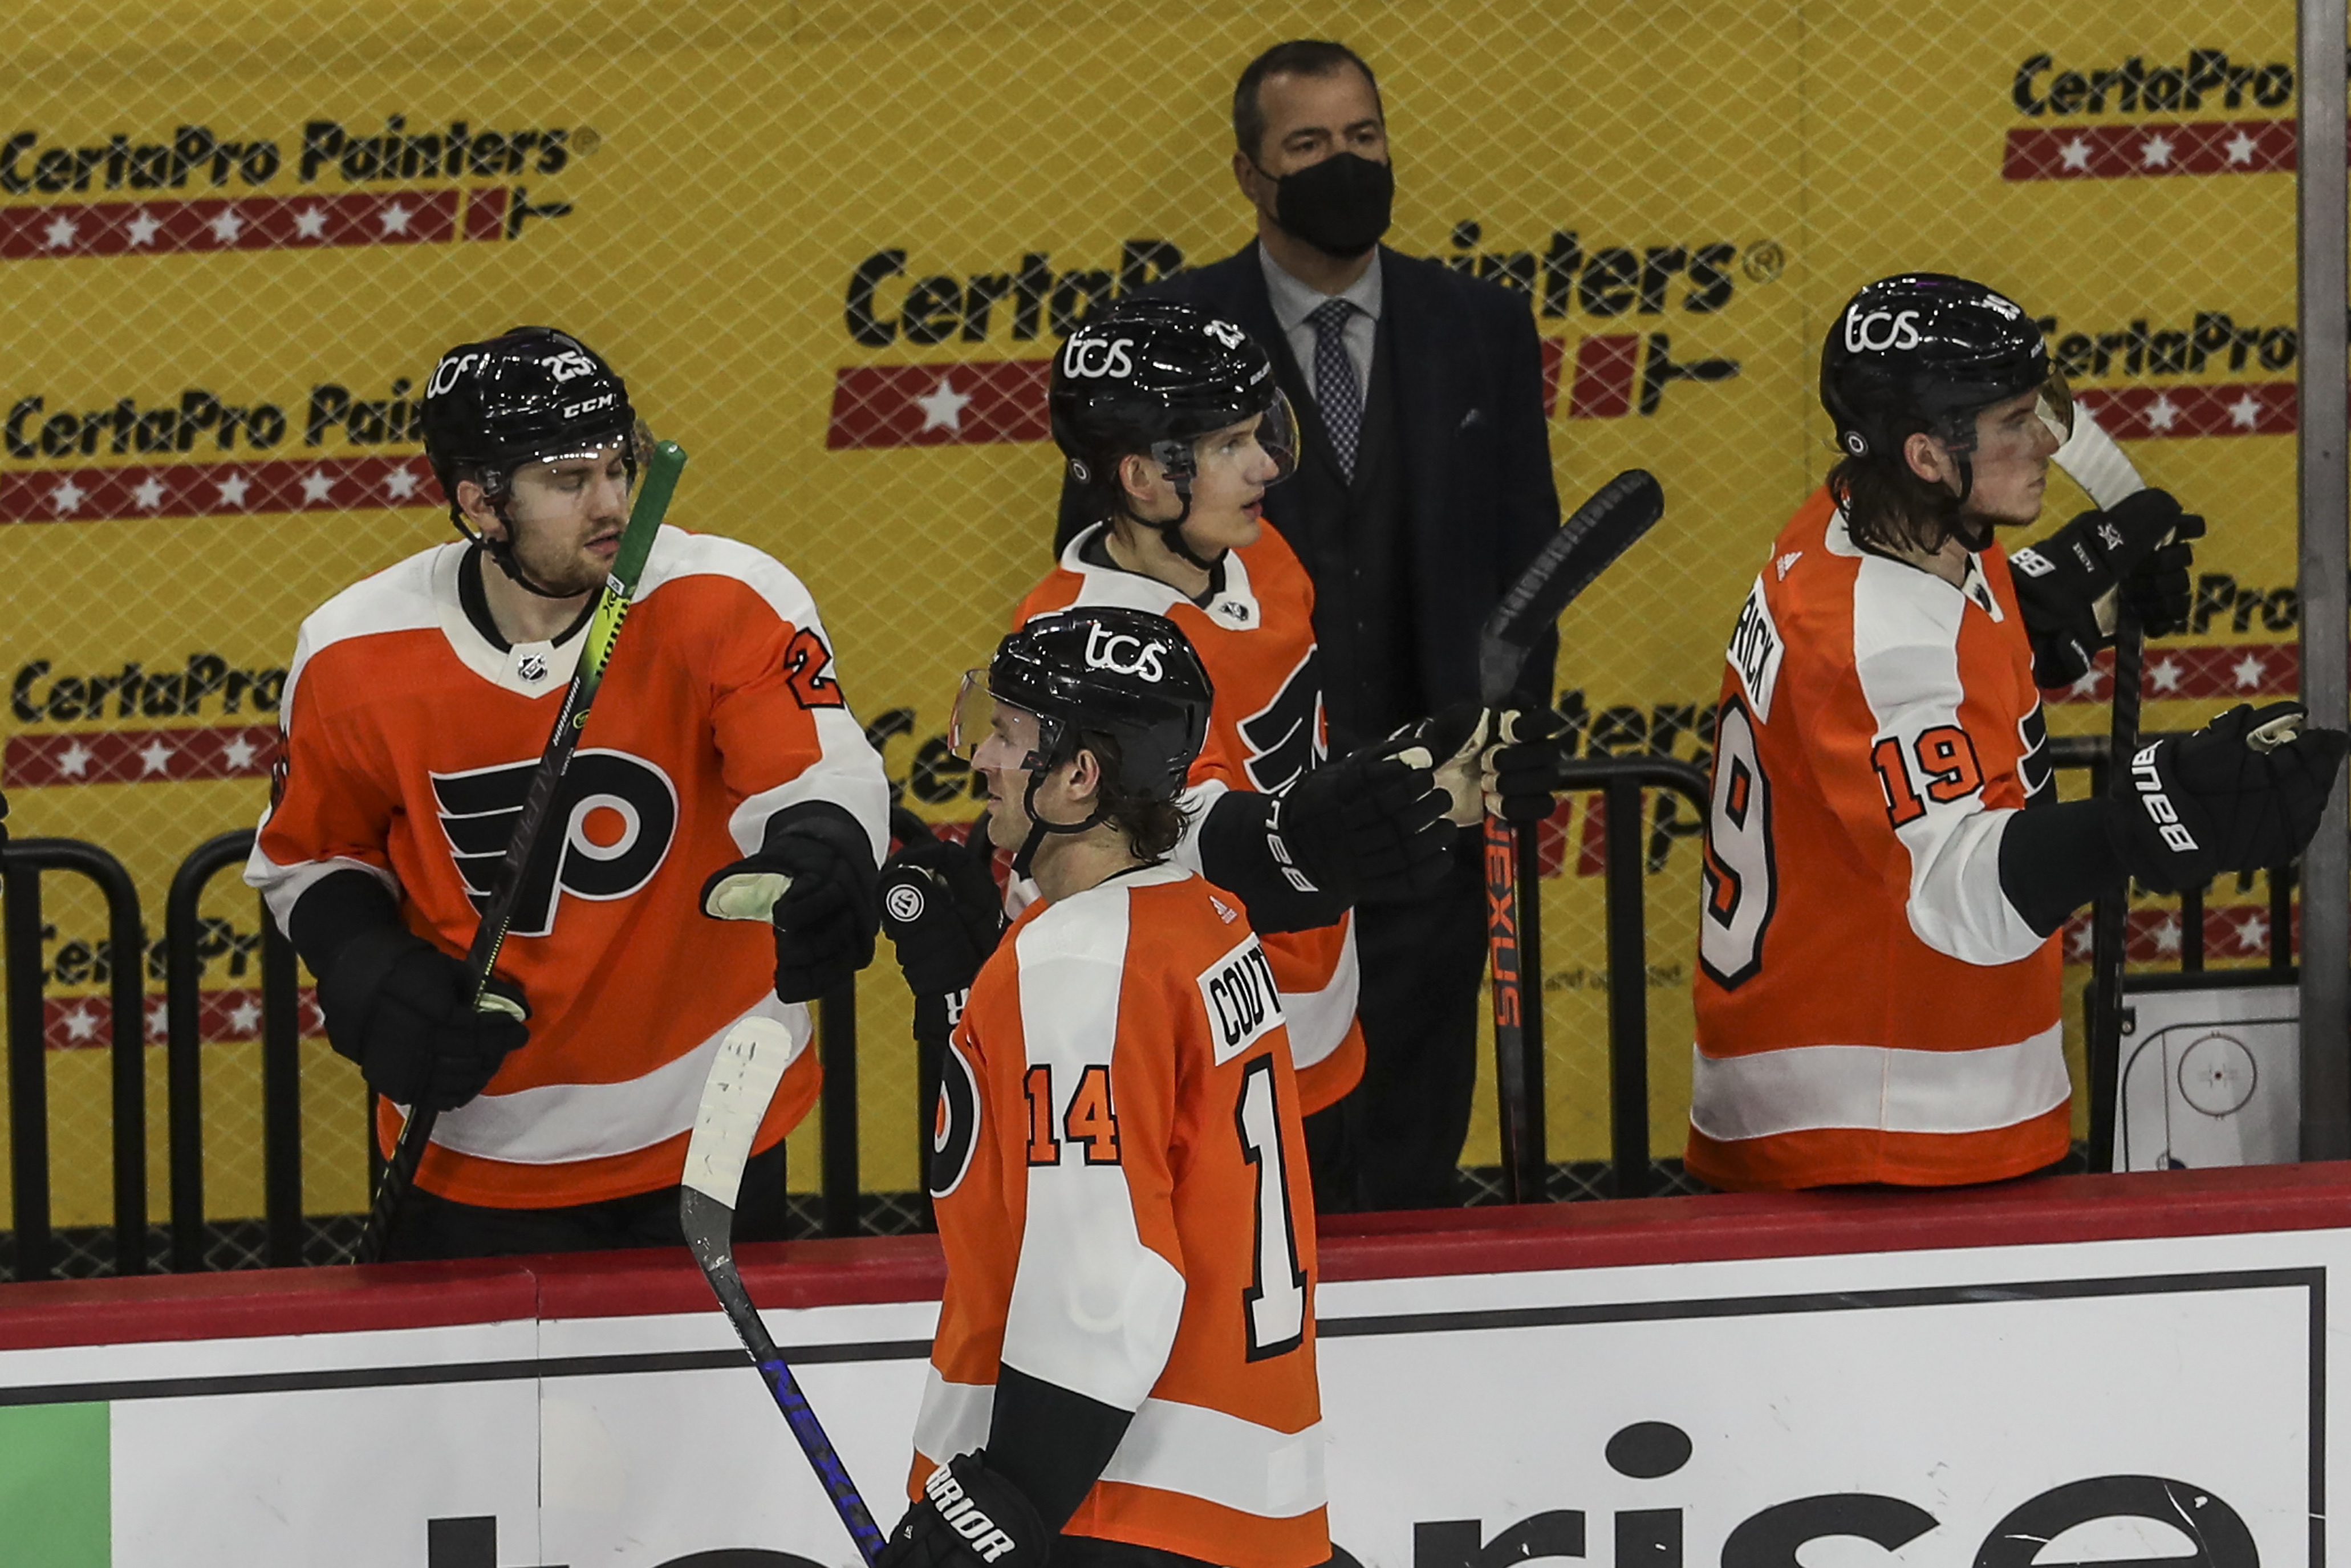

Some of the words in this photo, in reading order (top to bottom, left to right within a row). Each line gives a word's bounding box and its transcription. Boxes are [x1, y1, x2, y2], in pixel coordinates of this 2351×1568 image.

[2012, 48, 2294, 116] CertaPro
[0, 125, 279, 194] CertaPro
[845, 238, 1187, 348] CertaP
[1063, 331, 1134, 379] tcs
[1845, 304, 1920, 353] tcs
[541, 350, 598, 383] 25
[5, 390, 286, 458] CertaPro
[562, 393, 615, 419] CCM
[1084, 621, 1167, 683] tcs
[10, 653, 287, 724] CertaPro
[1870, 724, 1984, 830] 19
[1023, 1064, 1122, 1167] 14
